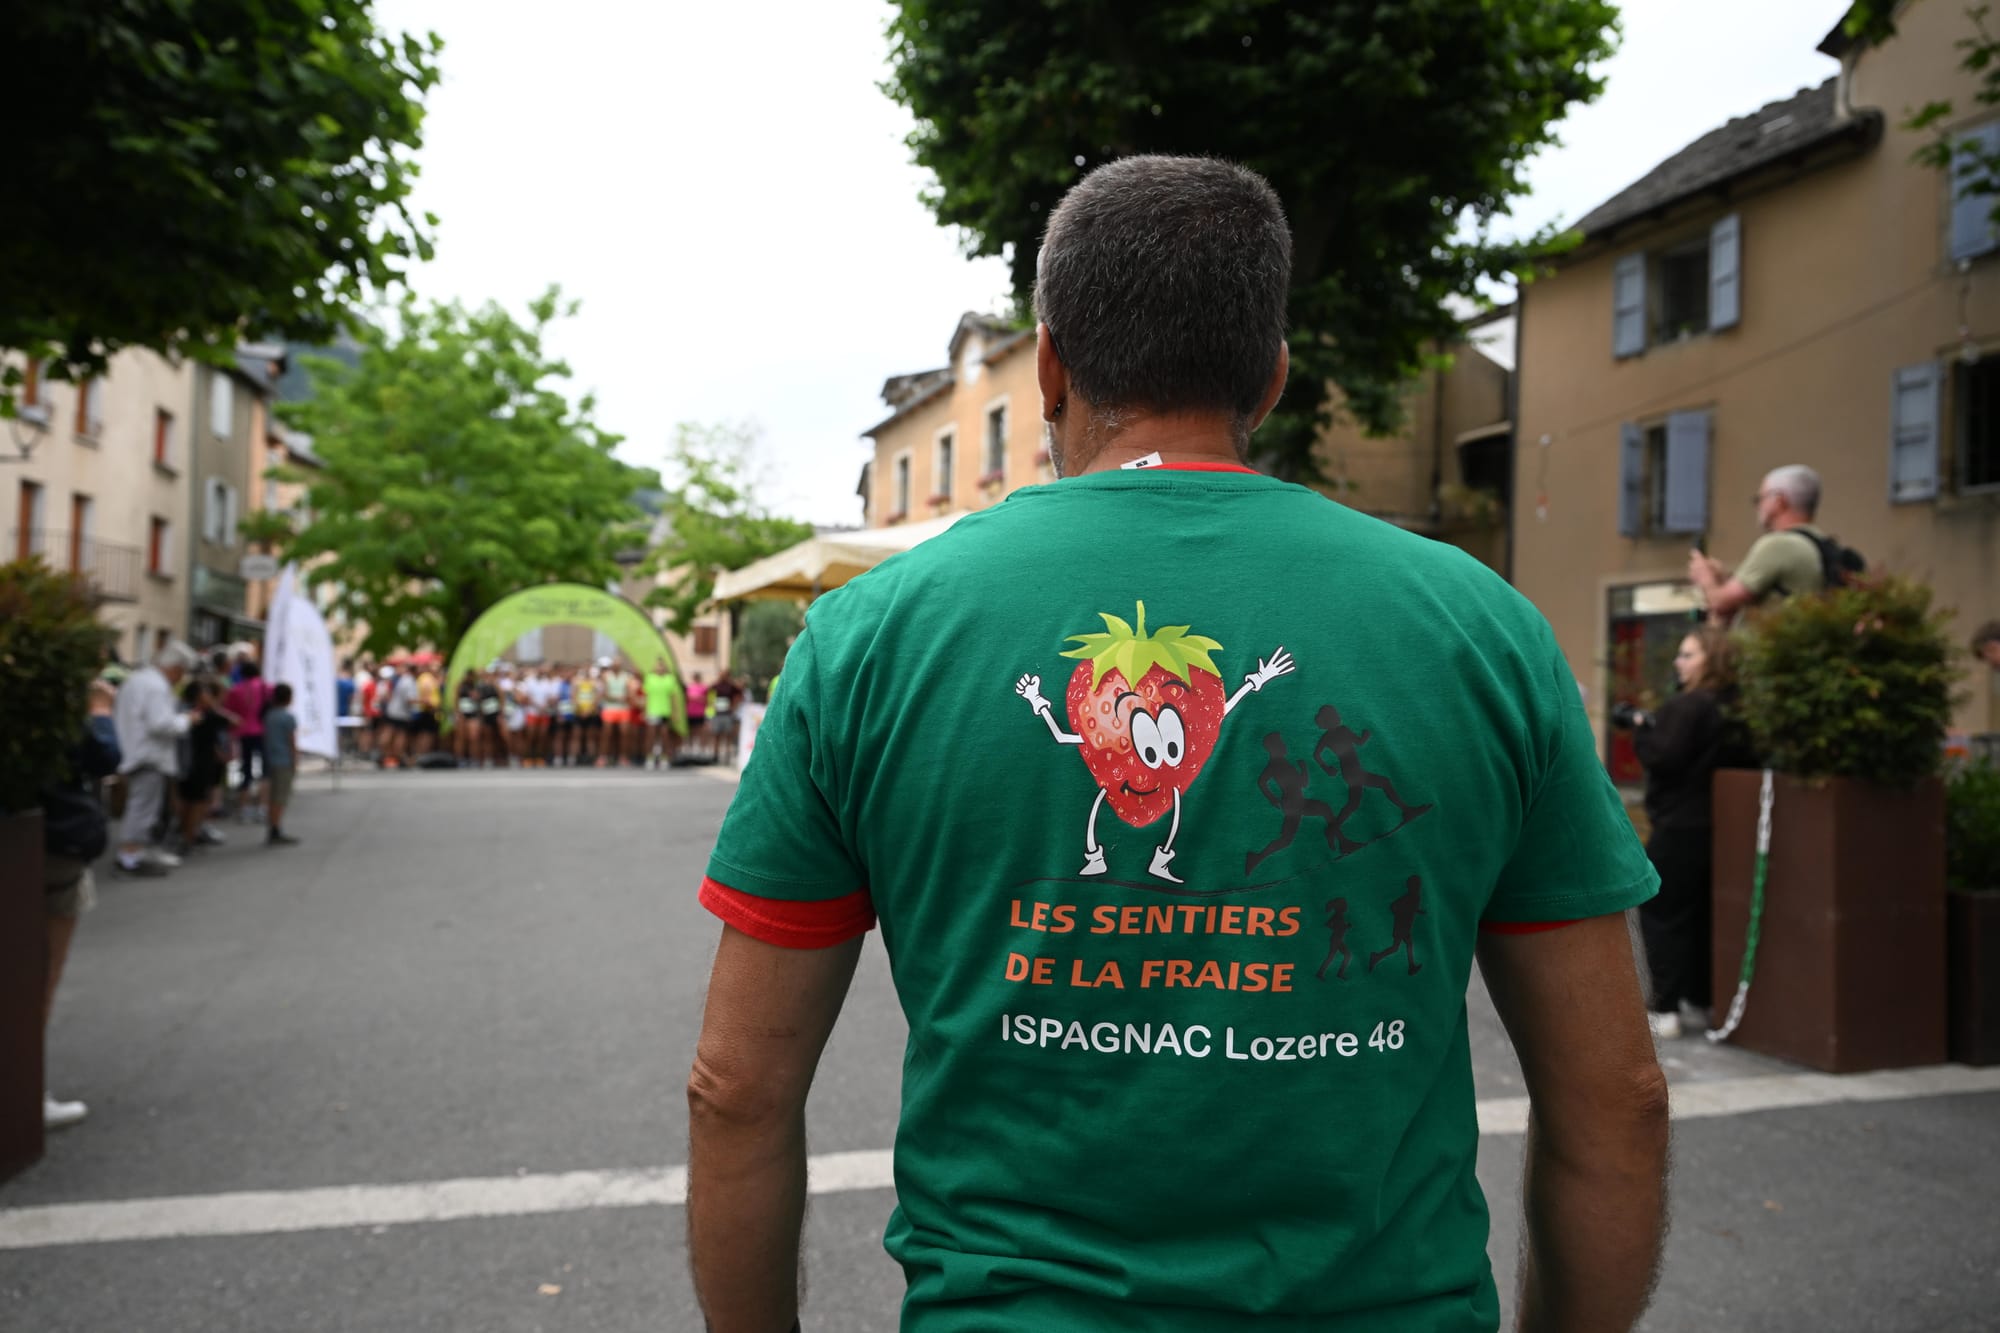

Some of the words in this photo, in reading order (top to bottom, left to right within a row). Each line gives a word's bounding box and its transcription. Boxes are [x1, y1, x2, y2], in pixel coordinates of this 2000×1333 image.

[1010, 900, 1077, 934] LES
[1090, 905, 1301, 937] SENTIERS
[1004, 952, 1056, 985] DE
[1070, 959, 1125, 989] LA
[1140, 960, 1295, 993] FRAISE
[1001, 1014, 1212, 1058] ISPAGNAC
[1225, 1026, 1359, 1062] Lozere
[1368, 1019, 1406, 1053] 48
